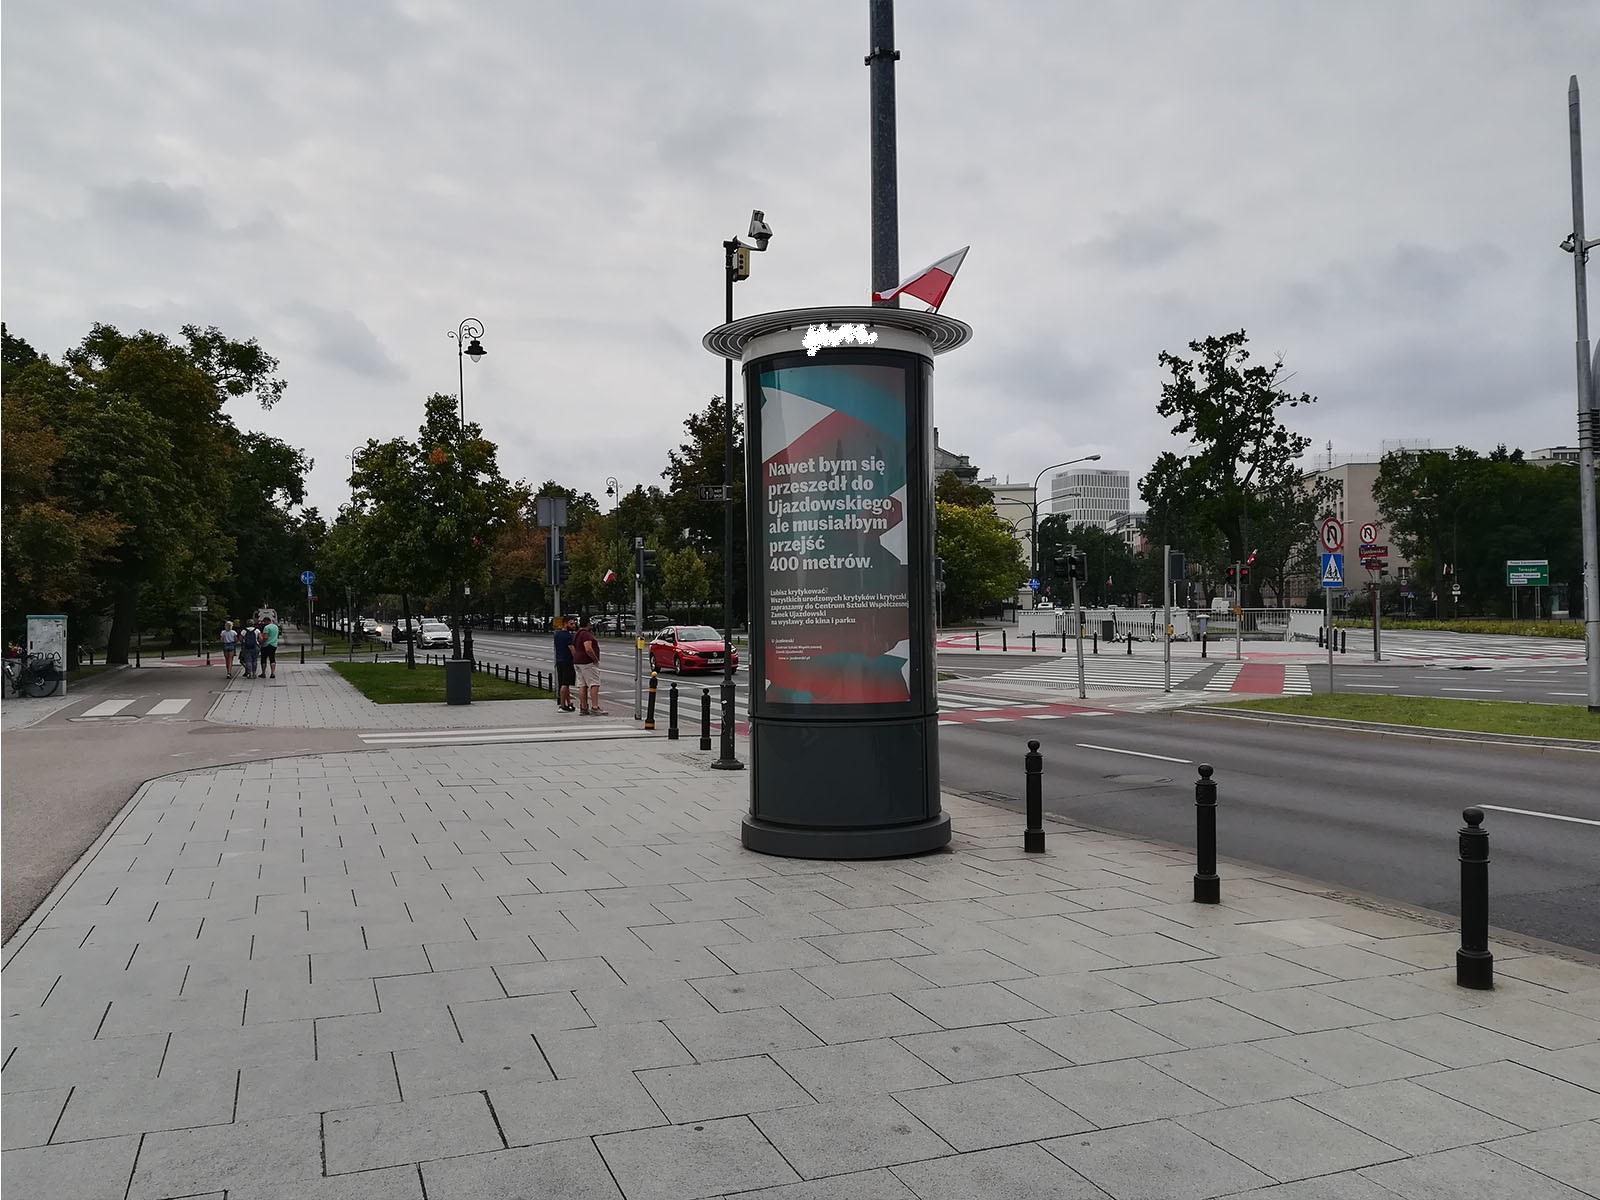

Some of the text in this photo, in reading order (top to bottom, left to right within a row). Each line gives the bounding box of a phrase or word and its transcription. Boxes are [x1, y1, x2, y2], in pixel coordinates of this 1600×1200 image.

[769, 455, 886, 477] Nawet bym się
[768, 475, 874, 500] przeszedł do
[768, 495, 895, 517] Ujazdowskiego,
[769, 514, 888, 534] ale musiałbym
[769, 535, 825, 556] przejść
[769, 553, 873, 572] 400 metrów.
[770, 596, 802, 604] Wszystkich
[802, 595, 843, 603] urodzonych
[843, 593, 876, 602] krytyków
[879, 593, 907, 602] krytyczki
[770, 604, 804, 612] zapraszamy
[845, 601, 868, 609] Sztuki
[789, 610, 826, 618] Ujazdowski
[834, 617, 856, 625] parku
